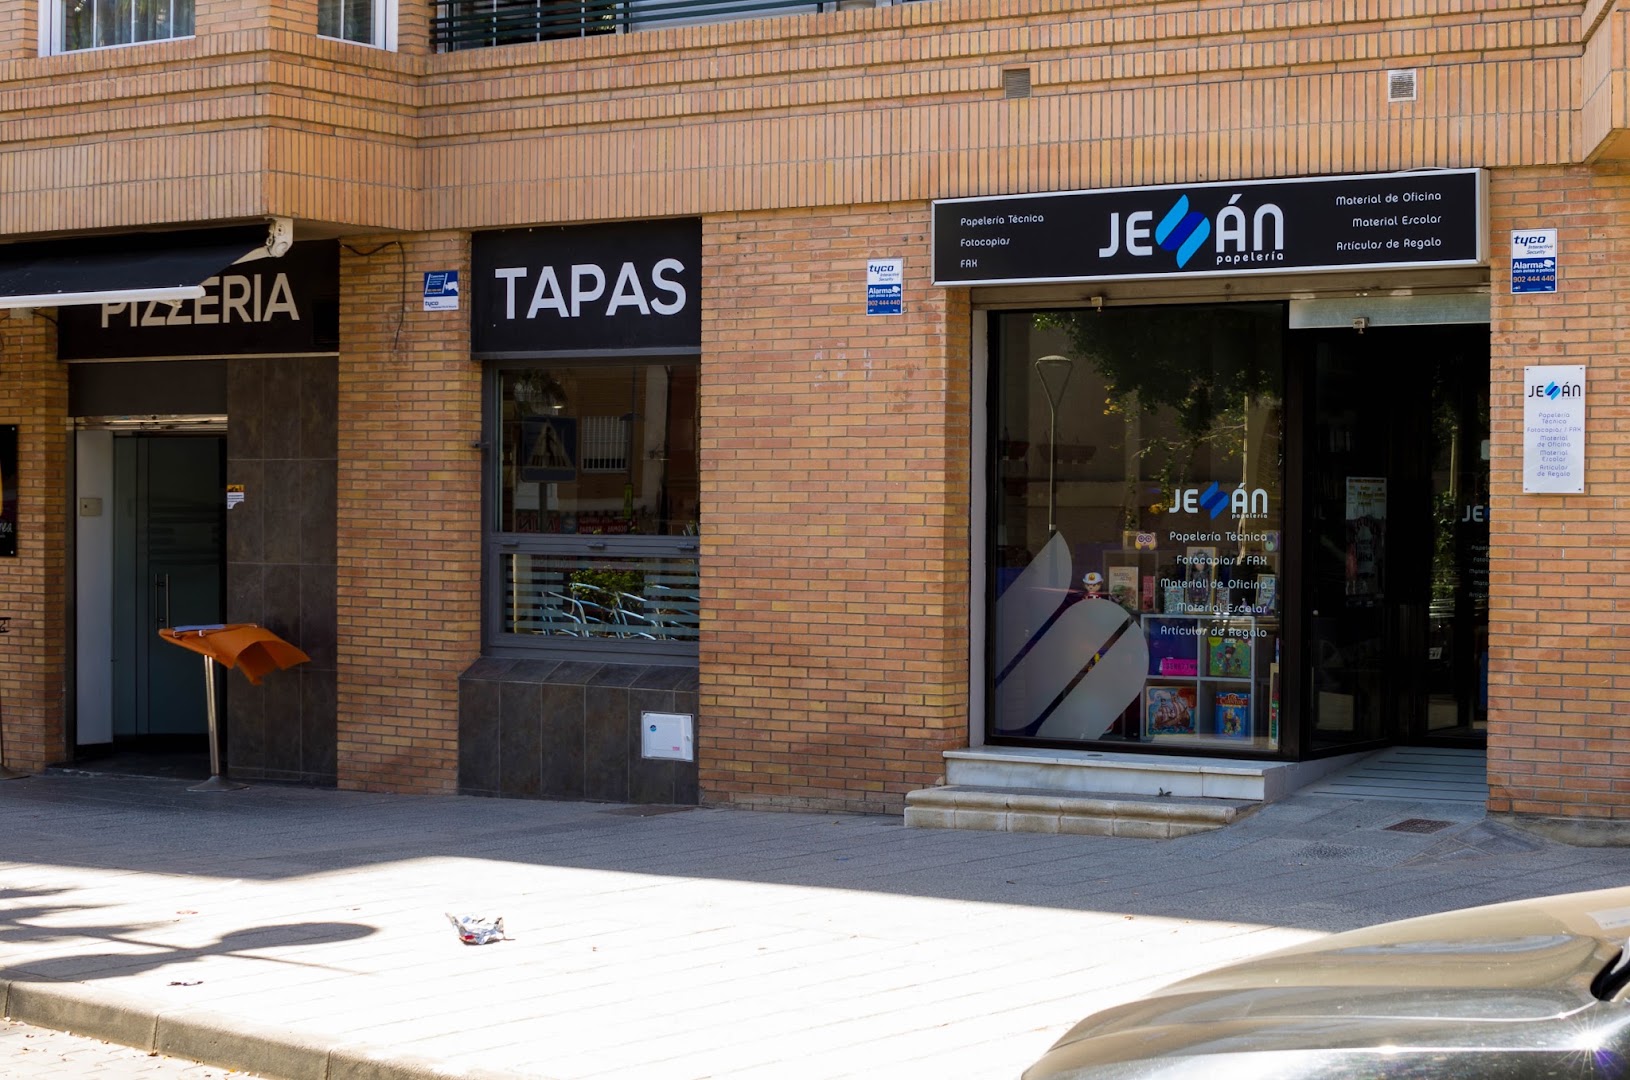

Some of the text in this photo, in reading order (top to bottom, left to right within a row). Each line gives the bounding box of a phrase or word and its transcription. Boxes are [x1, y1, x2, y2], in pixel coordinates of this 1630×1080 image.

[1335, 191, 1442, 206] Material de Oficina
[960, 214, 1045, 228] Papelería Técnica
[1352, 214, 1442, 227] Material Escolar
[960, 236, 1011, 248] Fotocopias
[1336, 237, 1442, 251] Artículos de Regalo
[1513, 235, 1546, 247] tyco
[960, 258, 978, 268] FAX
[1216, 251, 1284, 265] papelería
[869, 264, 894, 274] tyco
[1513, 261, 1544, 269] Alarma
[1541, 274, 1555, 282] 440
[494, 257, 687, 320] TAPAS
[869, 287, 892, 295] Alarma
[1547, 470, 1571, 478] Regalo
[1169, 531, 1268, 543] Papelería Técnica
[1176, 554, 1235, 567] Fotocopias
[1246, 555, 1268, 566] FAX
[1160, 577, 1268, 590] Material de Oficina
[1176, 601, 1268, 613] Material Escolar
[1160, 625, 1268, 639] Artículos de Regalo
